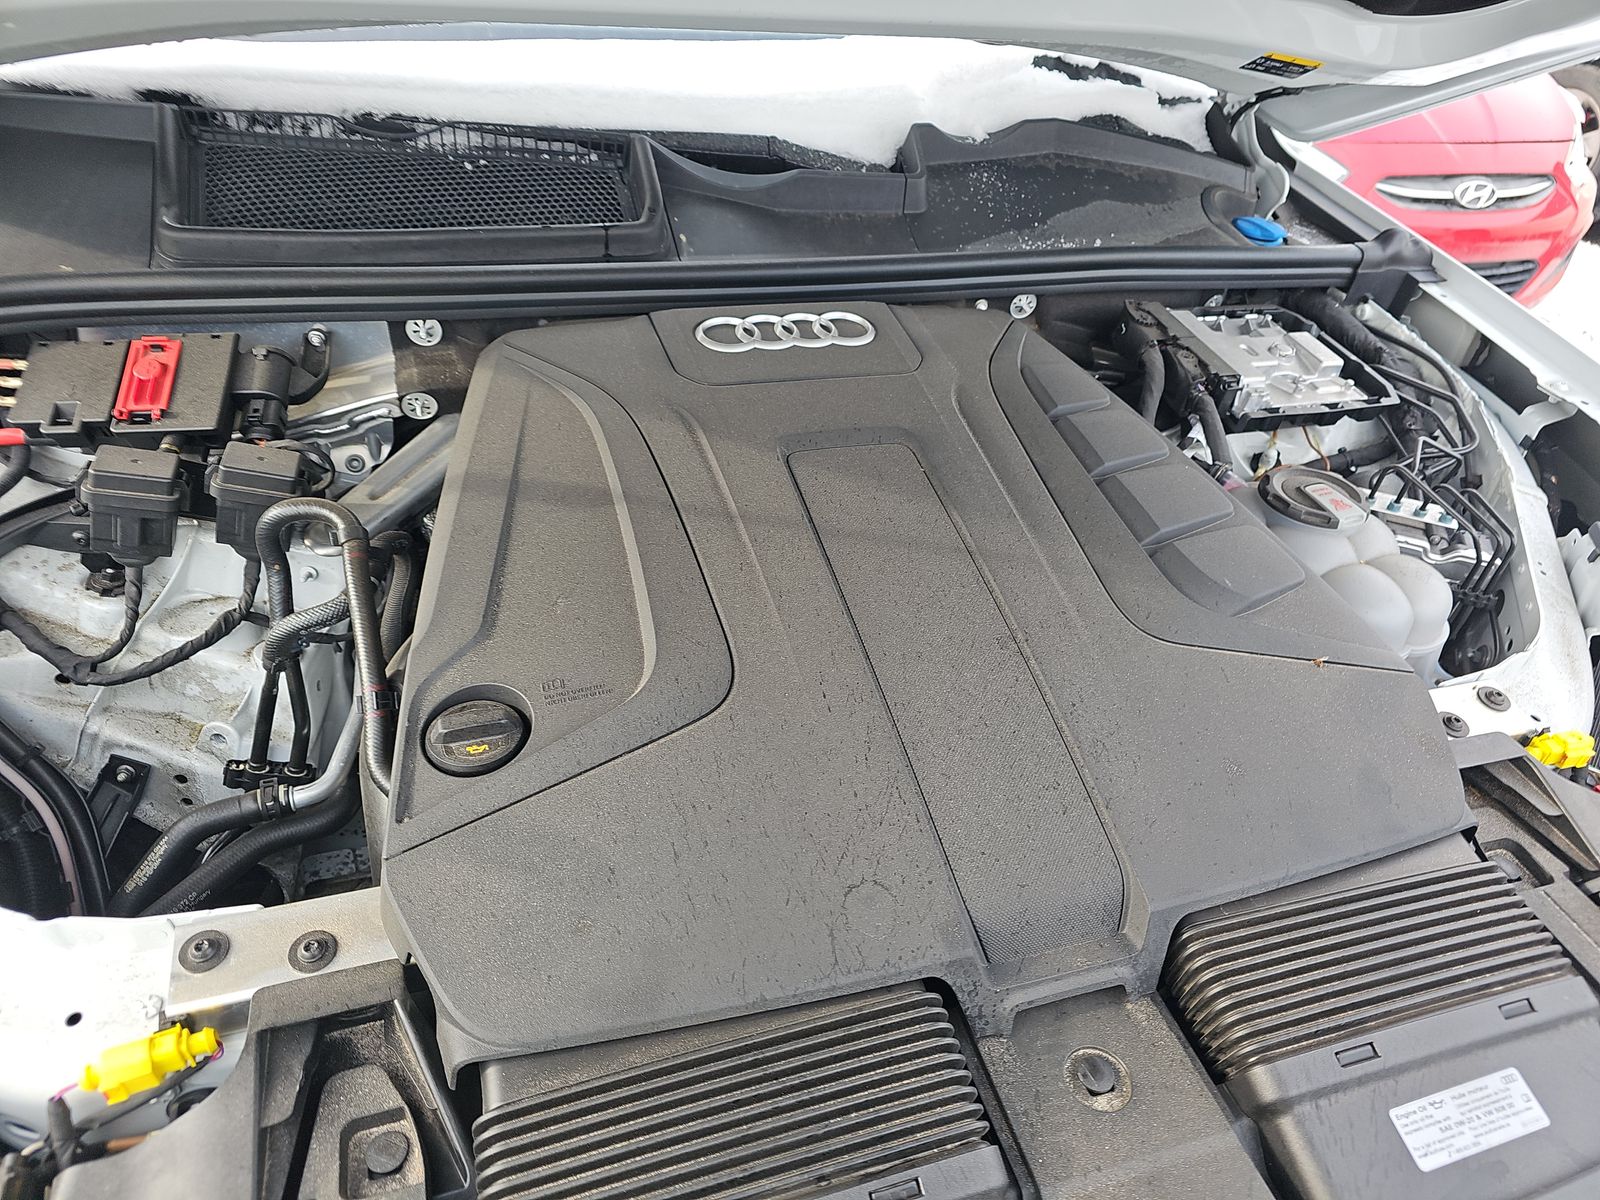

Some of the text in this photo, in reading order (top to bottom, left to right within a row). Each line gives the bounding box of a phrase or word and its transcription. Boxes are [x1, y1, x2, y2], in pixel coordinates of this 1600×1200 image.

[177, 899, 188, 908] 372
[189, 889, 211, 908] Hungary
[1395, 1104, 1427, 1121] Engine Oil
